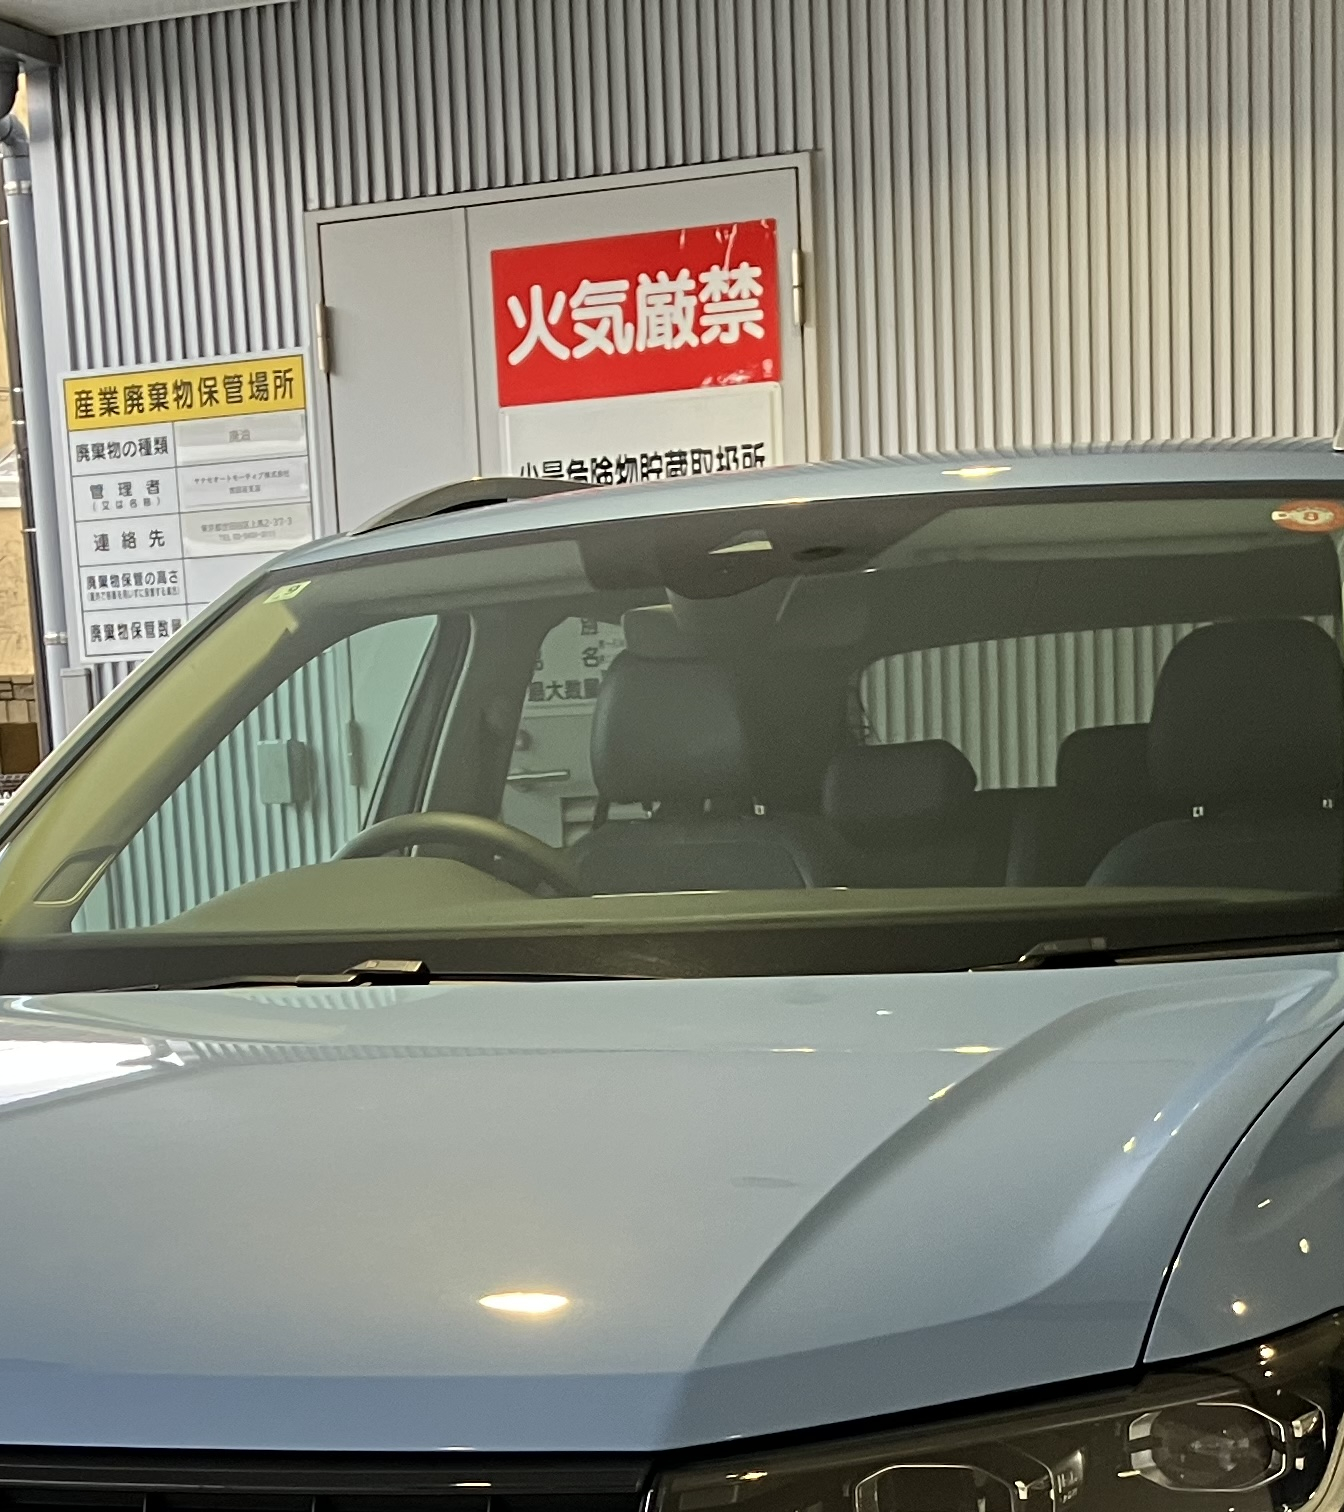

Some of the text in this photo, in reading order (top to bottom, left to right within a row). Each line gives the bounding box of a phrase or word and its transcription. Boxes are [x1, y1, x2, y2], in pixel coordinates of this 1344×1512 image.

[506, 261, 766, 366] 火気厳禁
[73, 367, 294, 420] 産業廃棄物保管場所
[75, 436, 168, 463] 廃棄物の種類
[89, 479, 160, 500] 管理者
[93, 528, 166, 553] 連絡先
